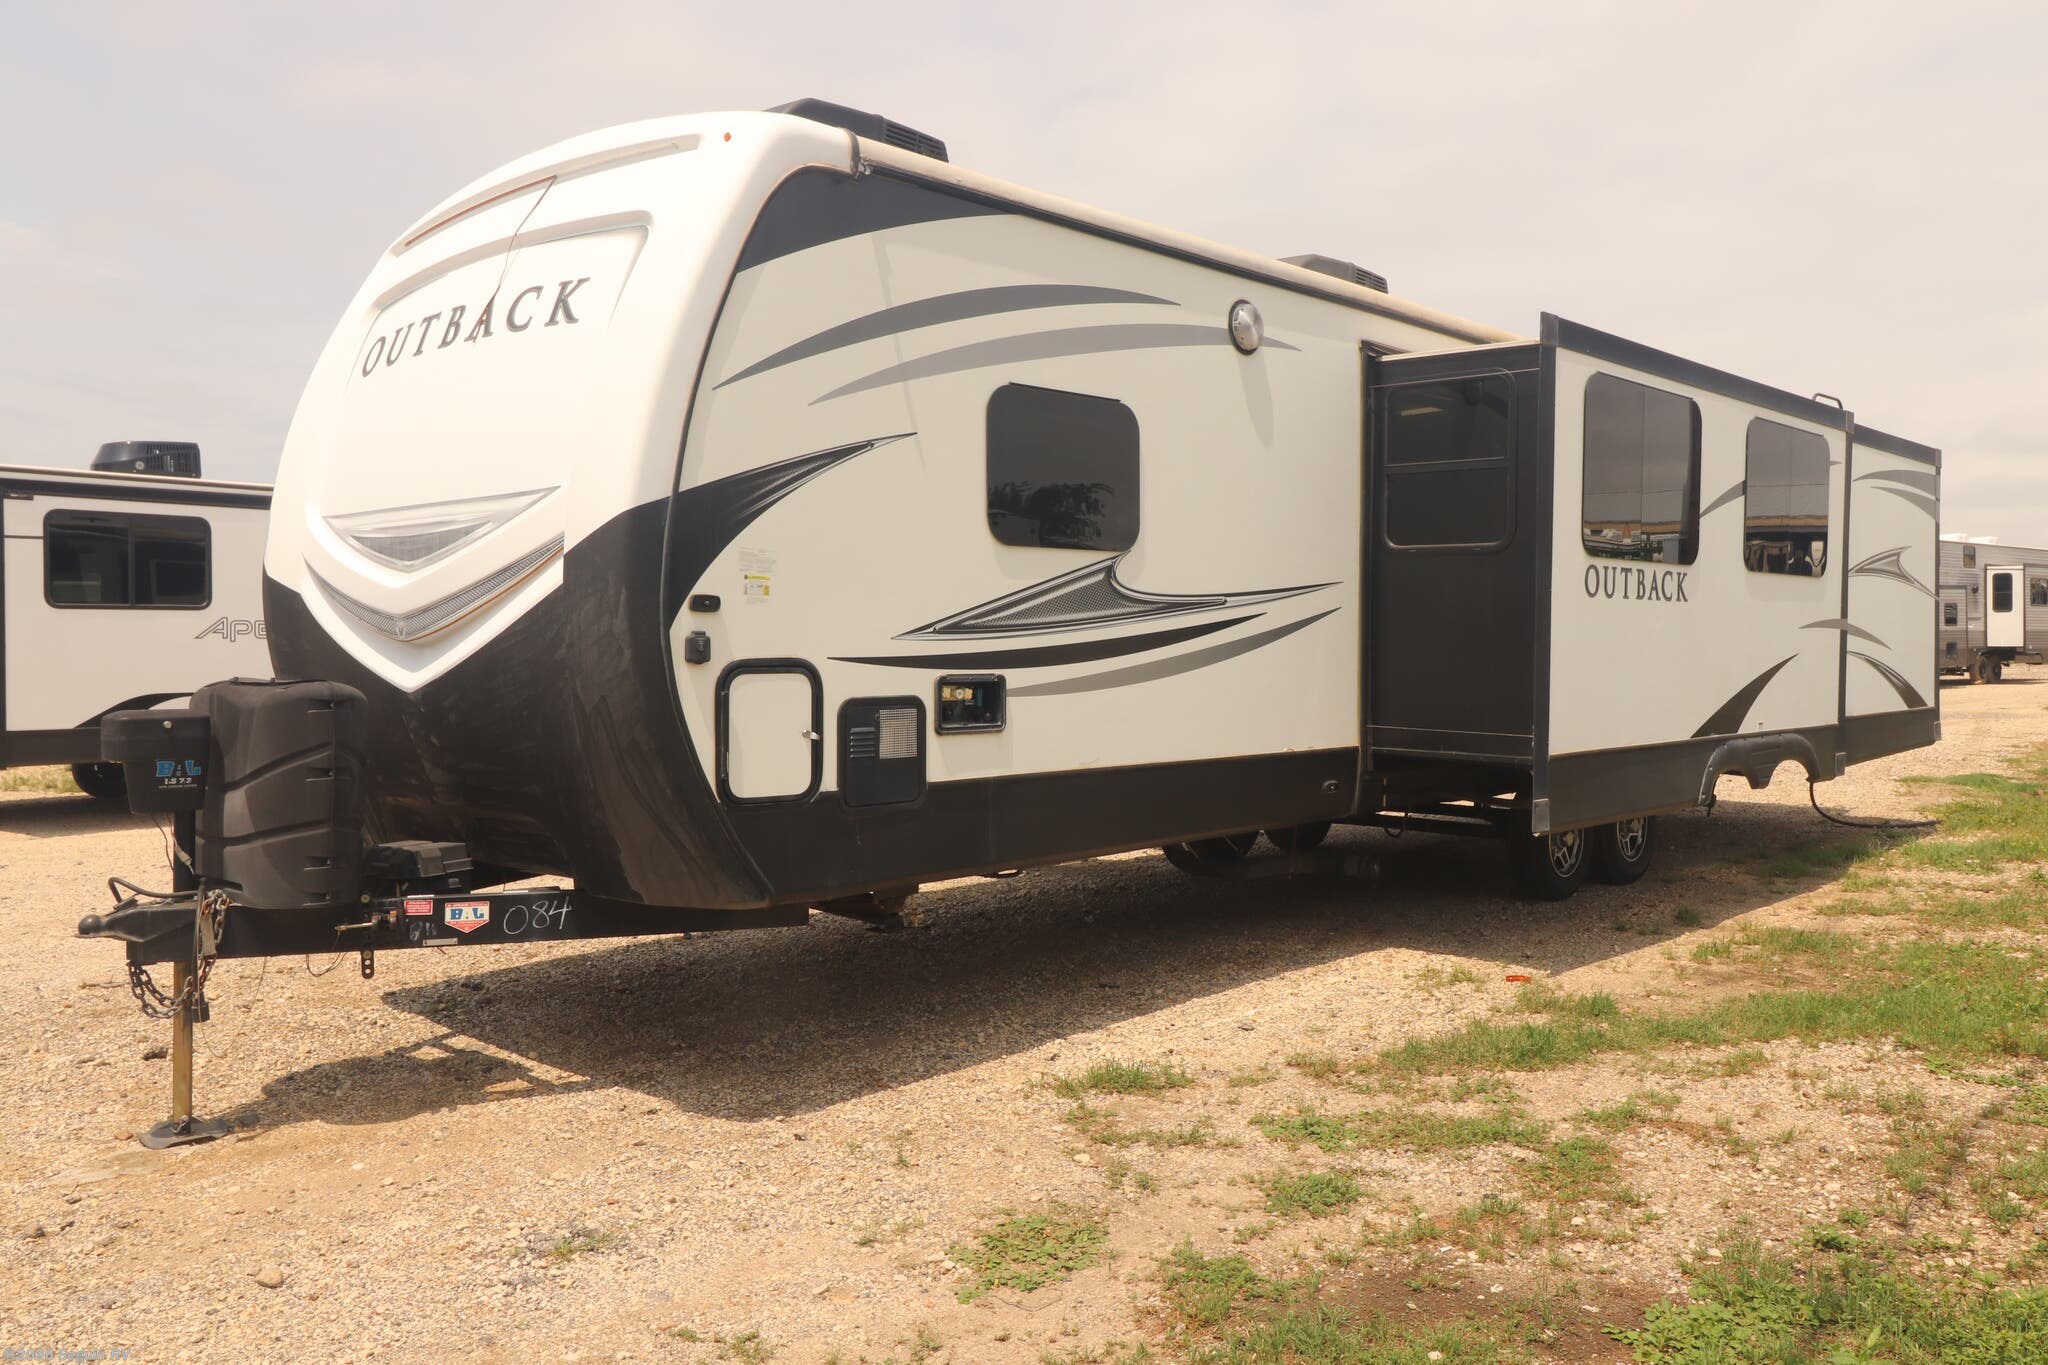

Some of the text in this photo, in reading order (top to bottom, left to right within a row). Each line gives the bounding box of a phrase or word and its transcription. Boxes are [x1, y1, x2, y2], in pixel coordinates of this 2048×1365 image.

[362, 277, 590, 377] OUTBACK
[1585, 564, 1688, 602] OUTBACK
[450, 907, 485, 920] BAL
[503, 896, 573, 935] 084
